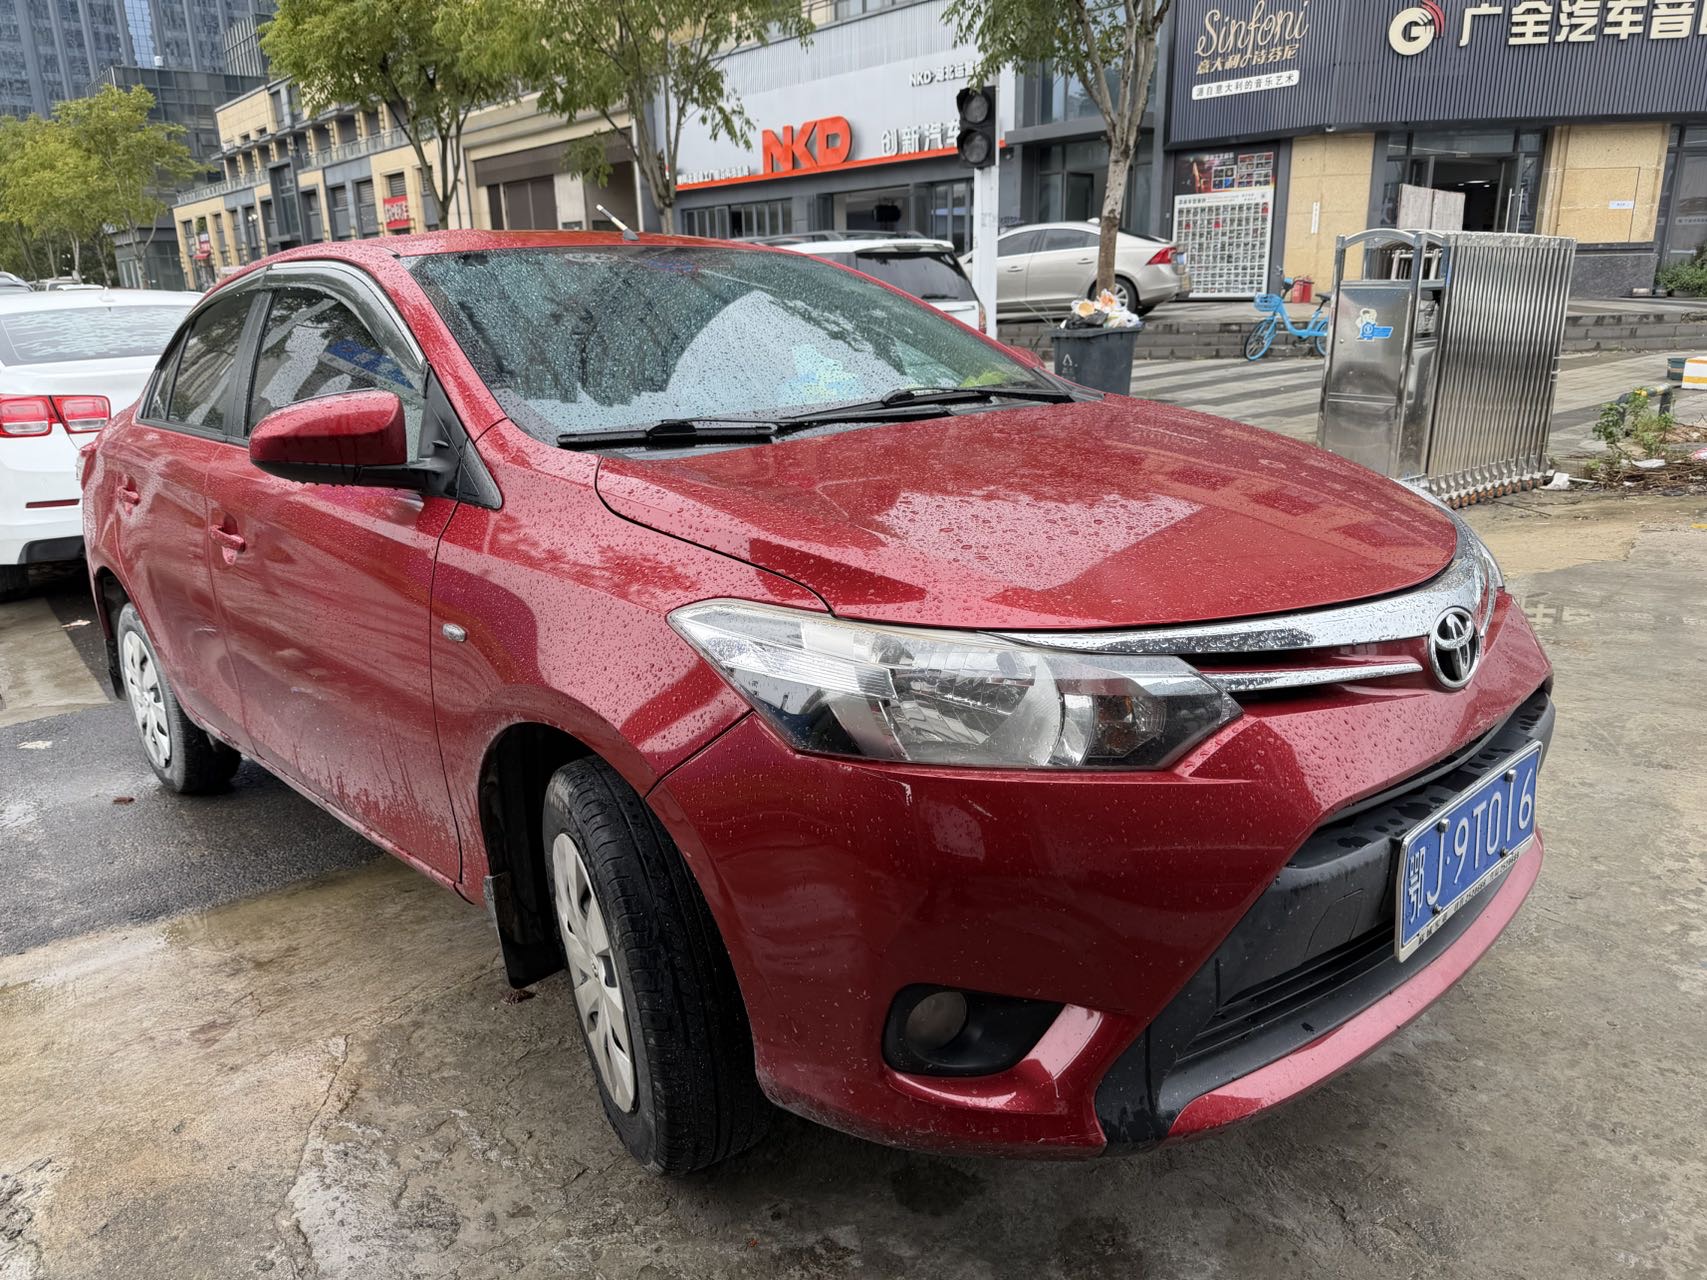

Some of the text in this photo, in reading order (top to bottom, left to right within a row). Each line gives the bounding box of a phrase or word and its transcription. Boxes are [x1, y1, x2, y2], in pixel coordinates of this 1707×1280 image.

[1194, 0, 1309, 68] Sinfoni
[1459, 0, 1707, 47] 广全汽车音
[762, 115, 852, 175] NKD
